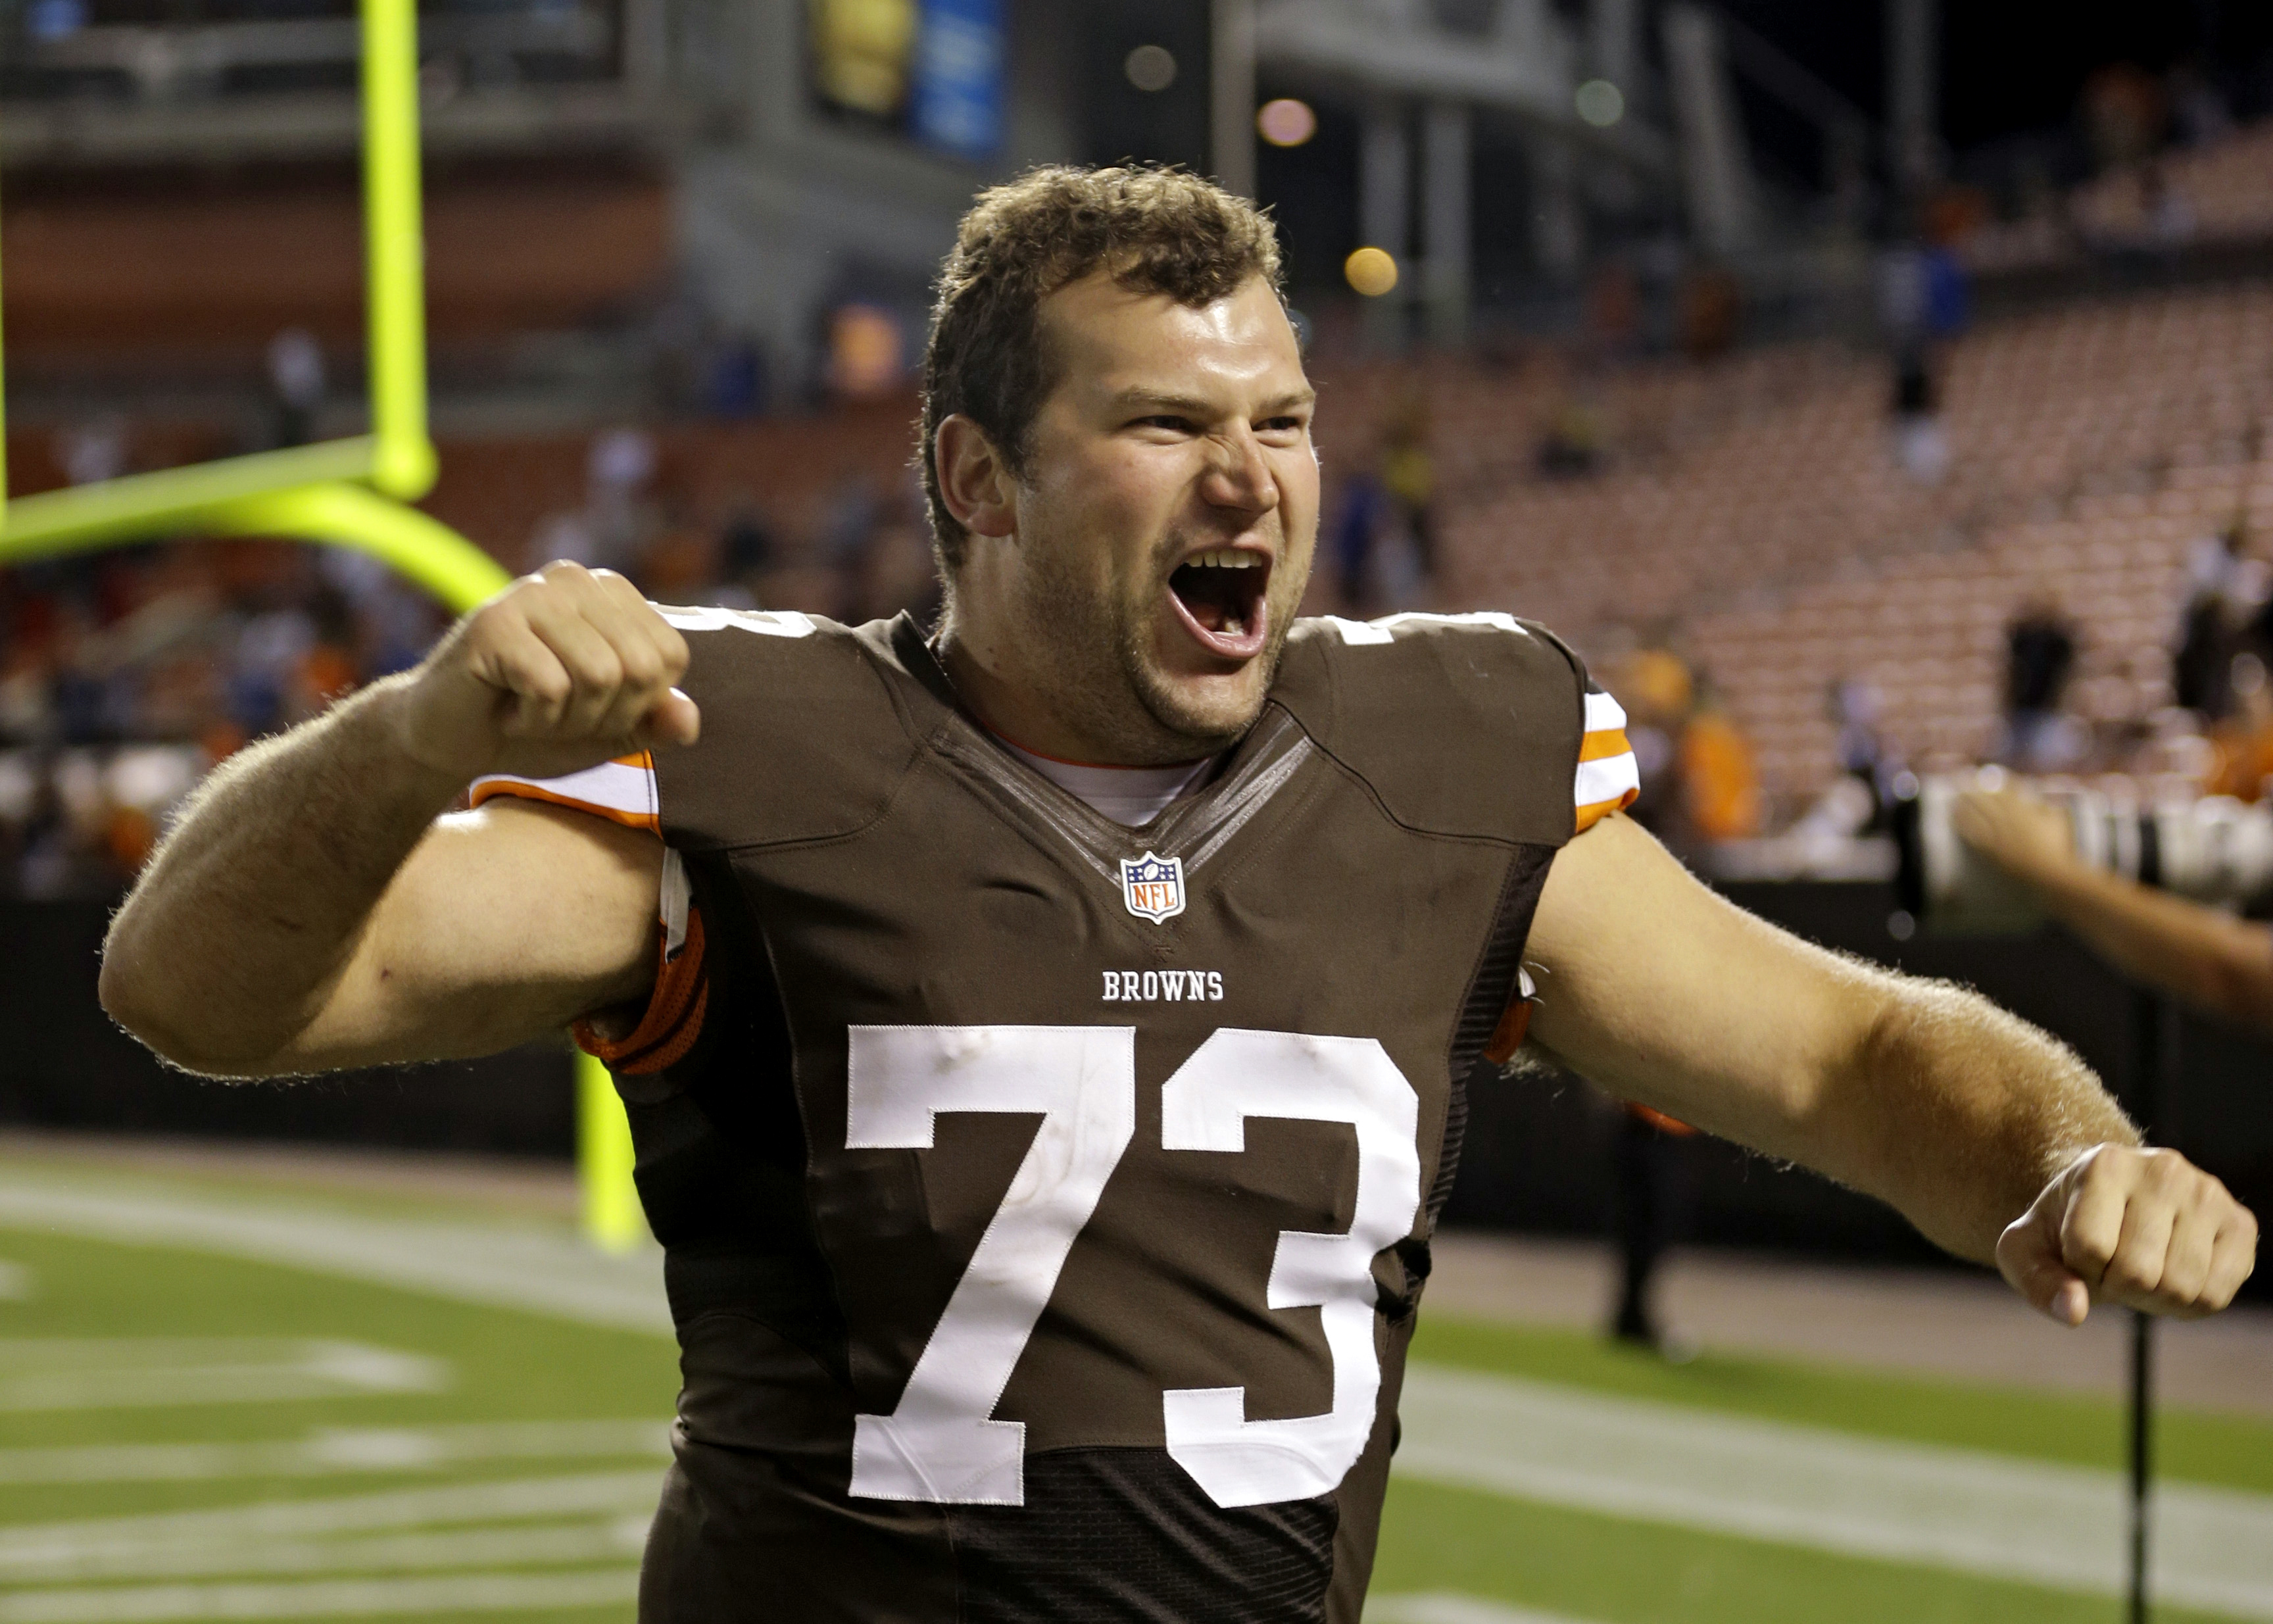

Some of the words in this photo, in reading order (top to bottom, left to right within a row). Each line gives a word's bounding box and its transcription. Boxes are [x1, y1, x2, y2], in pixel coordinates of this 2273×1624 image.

[1133, 883, 1175, 911] NFL
[1102, 971, 1223, 1001] BROWNS
[845, 1024, 1420, 1508] 73
